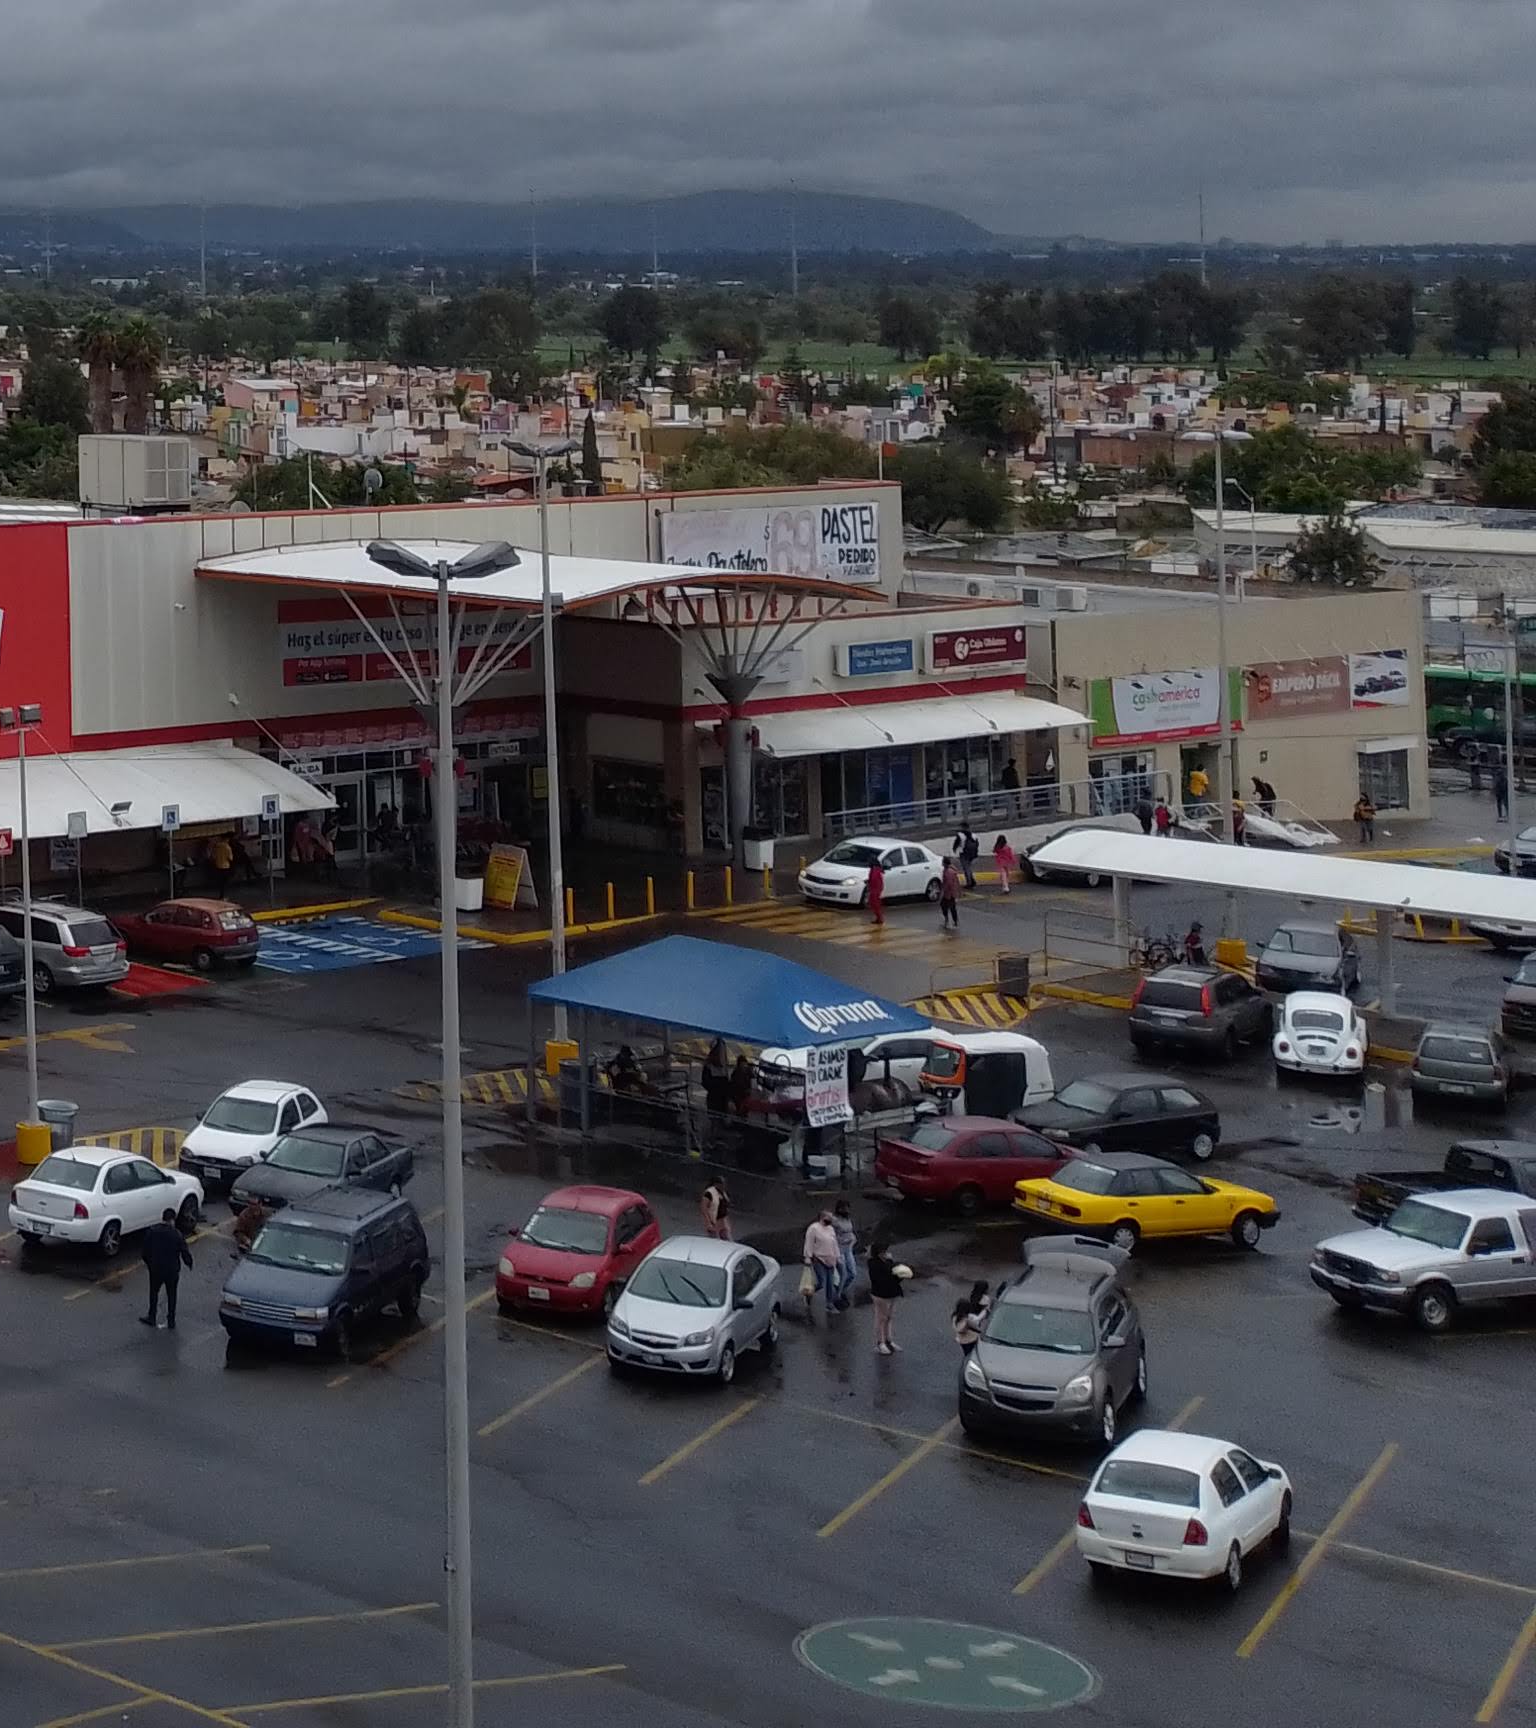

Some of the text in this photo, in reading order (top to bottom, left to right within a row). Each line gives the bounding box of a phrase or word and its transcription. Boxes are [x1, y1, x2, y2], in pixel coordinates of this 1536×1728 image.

[821, 505, 877, 545] PASTEL
[838, 548, 876, 565] PEDIDO
[287, 631, 312, 652] Haz
[313, 629, 324, 646] el
[327, 628, 361, 649] súper
[380, 627, 394, 641] tu
[1272, 672, 1314, 693] EMPEÑO
[794, 1000, 886, 1035] Corona
[818, 1064, 844, 1082] CARNE
